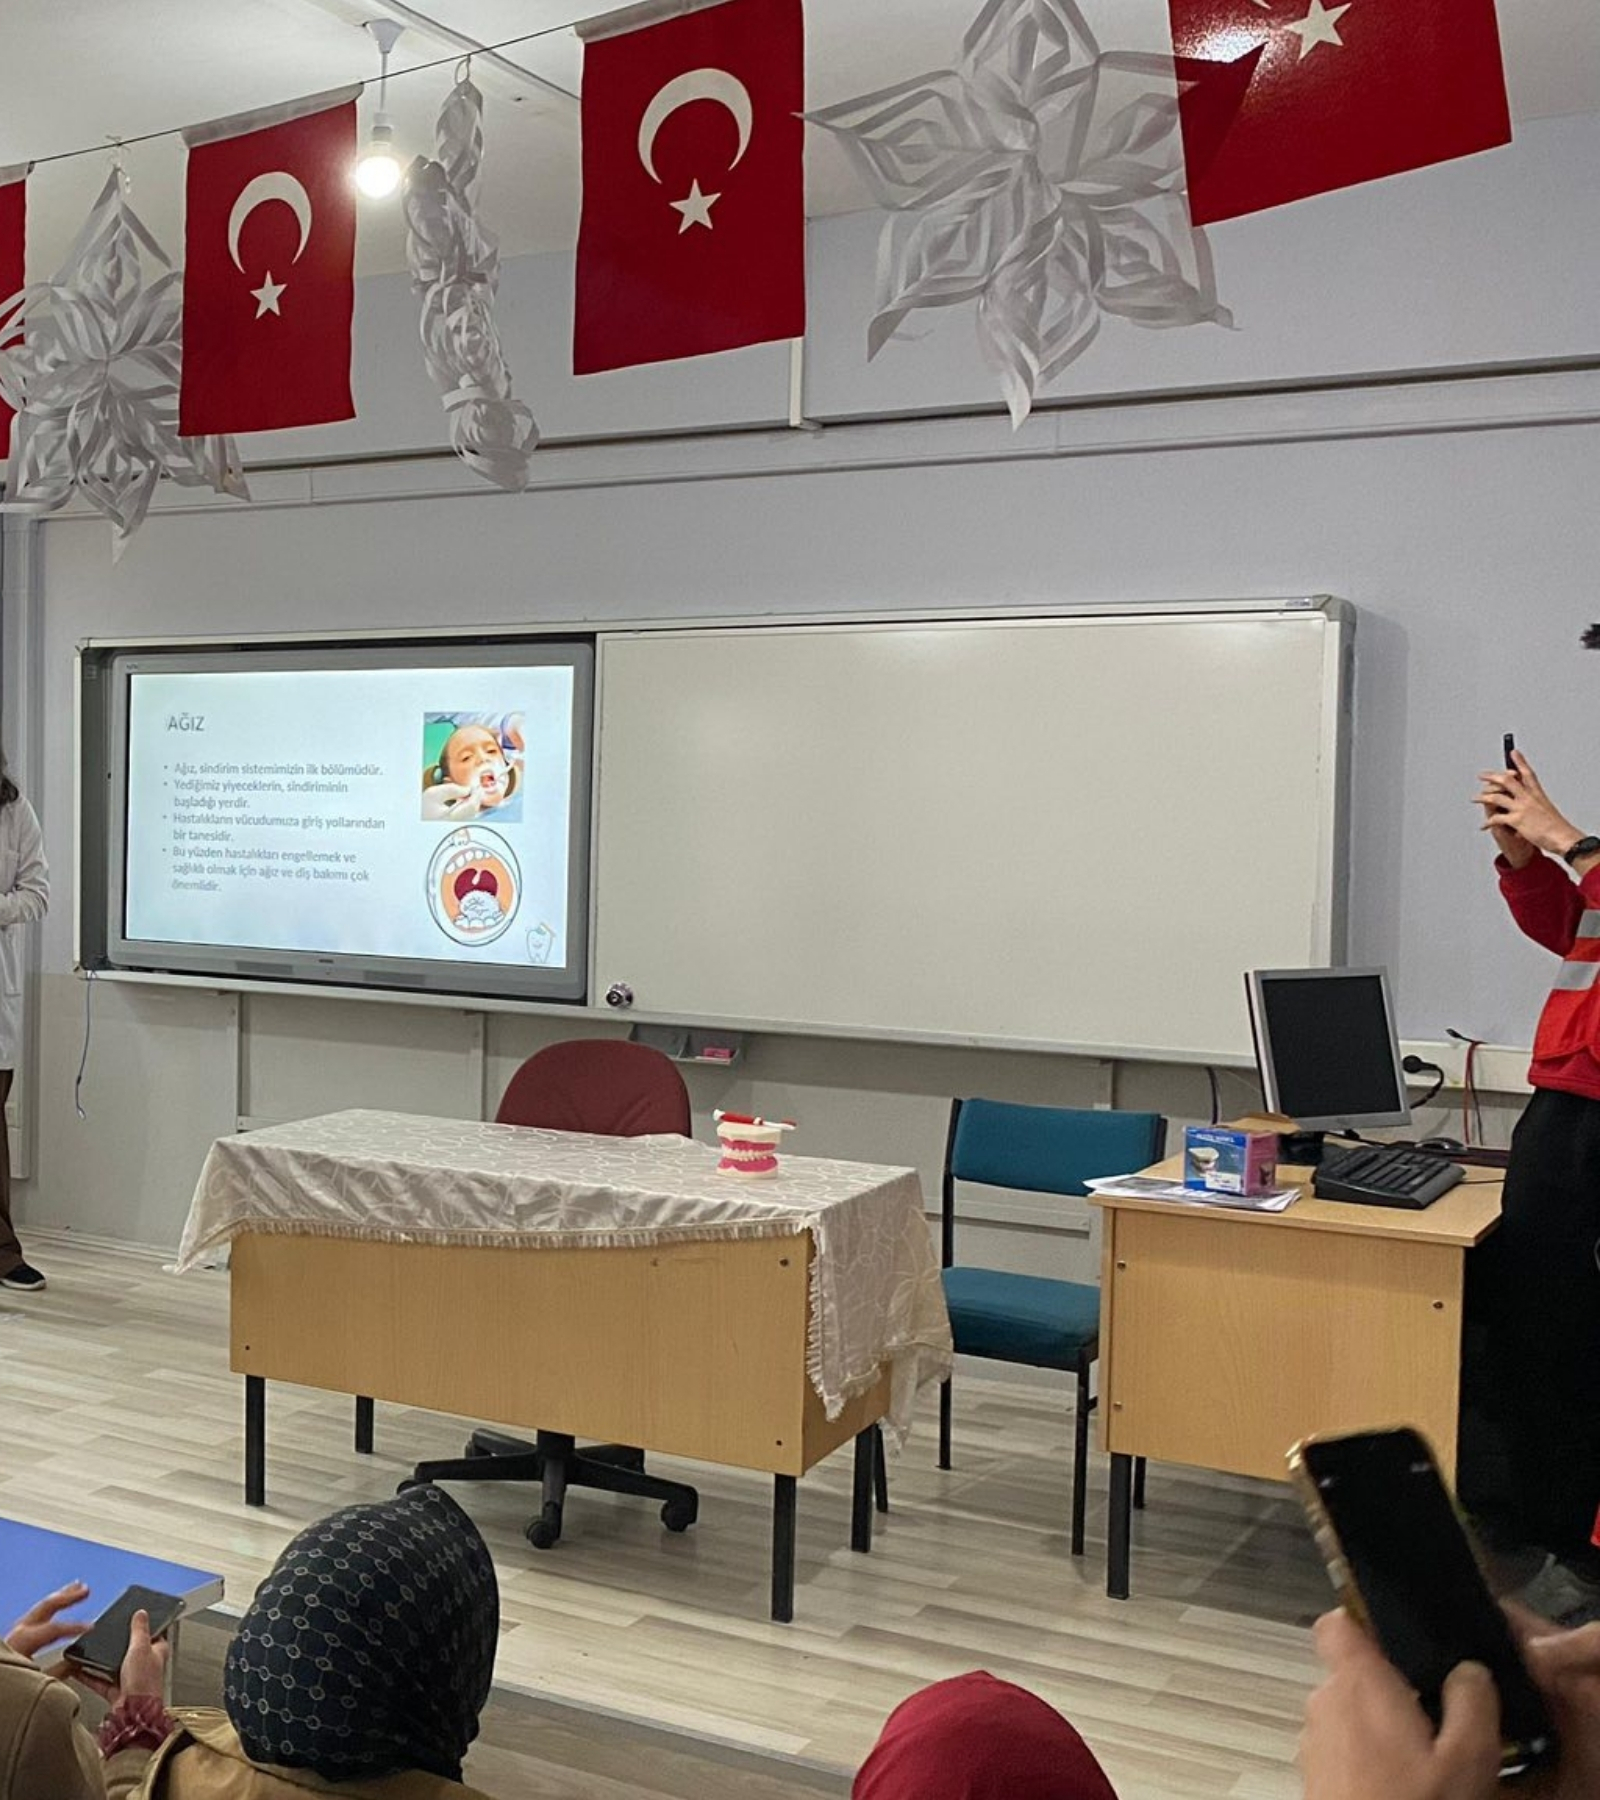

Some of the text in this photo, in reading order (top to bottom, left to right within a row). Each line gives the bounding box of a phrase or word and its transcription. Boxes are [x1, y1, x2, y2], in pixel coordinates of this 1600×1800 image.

[167, 712, 205, 732] AĞIZ
[199, 762, 240, 775] sindirim
[241, 762, 305, 776] sistemimizin
[321, 763, 384, 777] bölümüdür.
[174, 779, 349, 794] Yediğimiz yiyeceklerin, sindiriminin
[174, 795, 251, 810] başladığı yerdir.
[173, 812, 385, 831] Hastalıkların vücudumuza giriş yollarından
[173, 829, 187, 841] bir
[173, 846, 186, 857] Bu
[187, 846, 223, 859] yüzden
[281, 850, 341, 863] engellemek
[343, 853, 357, 864] ve
[206, 863, 237, 876] olmak
[350, 869, 369, 882] çok
